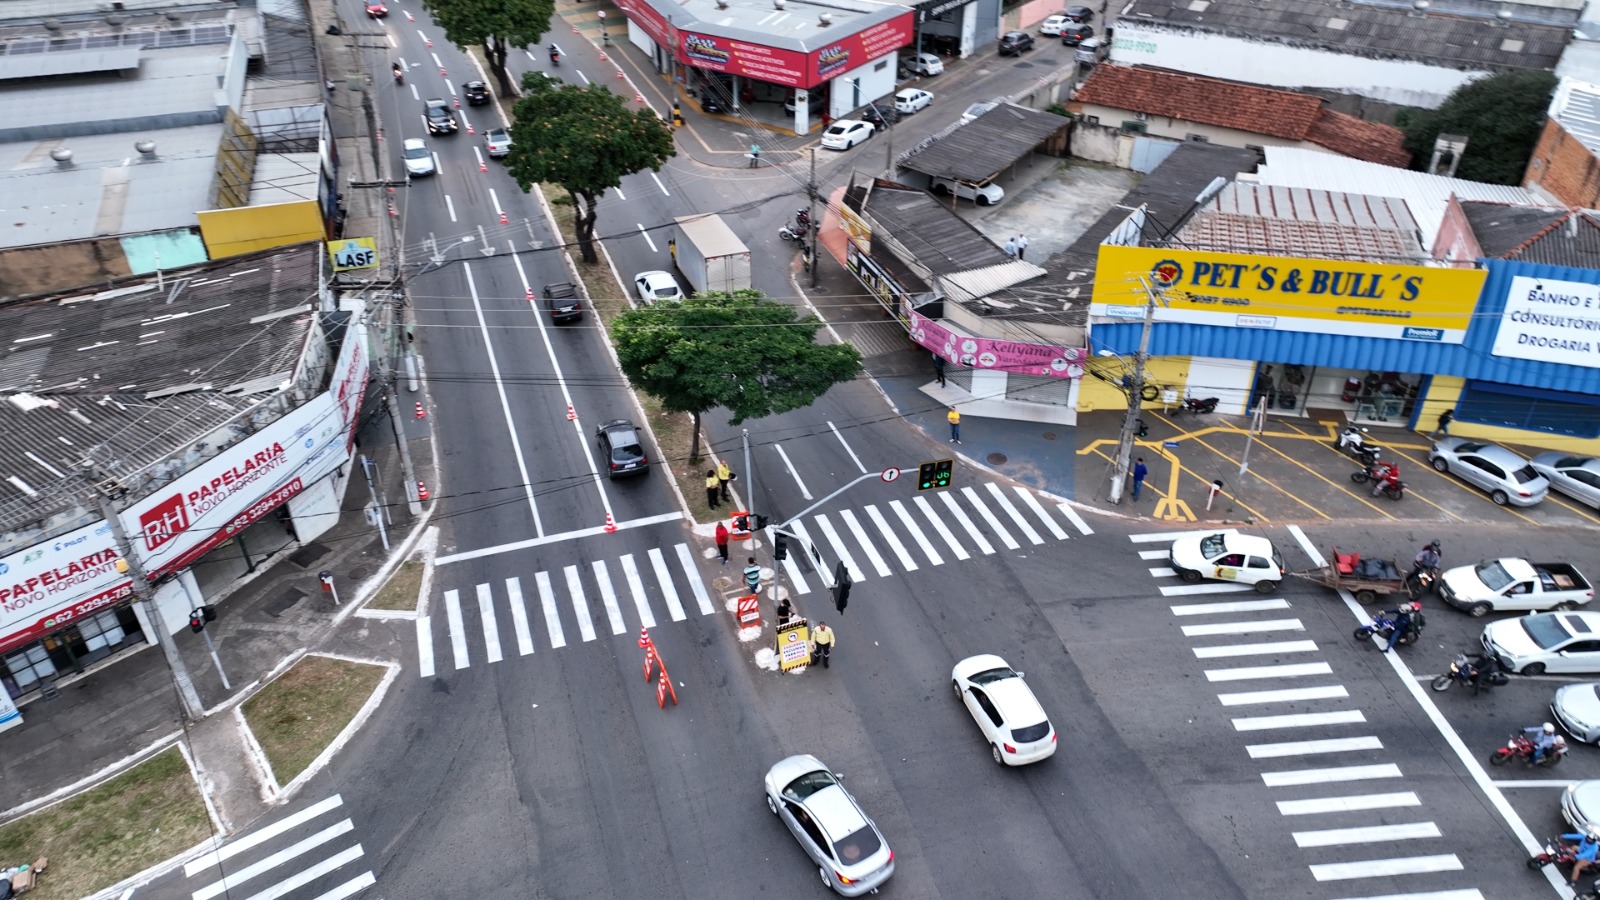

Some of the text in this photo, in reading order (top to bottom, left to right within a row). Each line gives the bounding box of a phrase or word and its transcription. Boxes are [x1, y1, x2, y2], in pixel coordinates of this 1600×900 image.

[334, 250, 374, 267] LASF
[1280, 267, 1302, 293] &
[1527, 289, 1592, 308] BANHO E
[1518, 333, 1591, 352] DROGARIA
[188, 442, 285, 506] PAPELARIA
[194, 454, 288, 518] NOVO HORIZONTE
[234, 515, 248, 529] 62
[250, 480, 301, 518] 3294-7810
[0, 547, 119, 604] PAPELARIA
[4, 590, 46, 614] NOVO
[55, 608, 74, 625] 62
